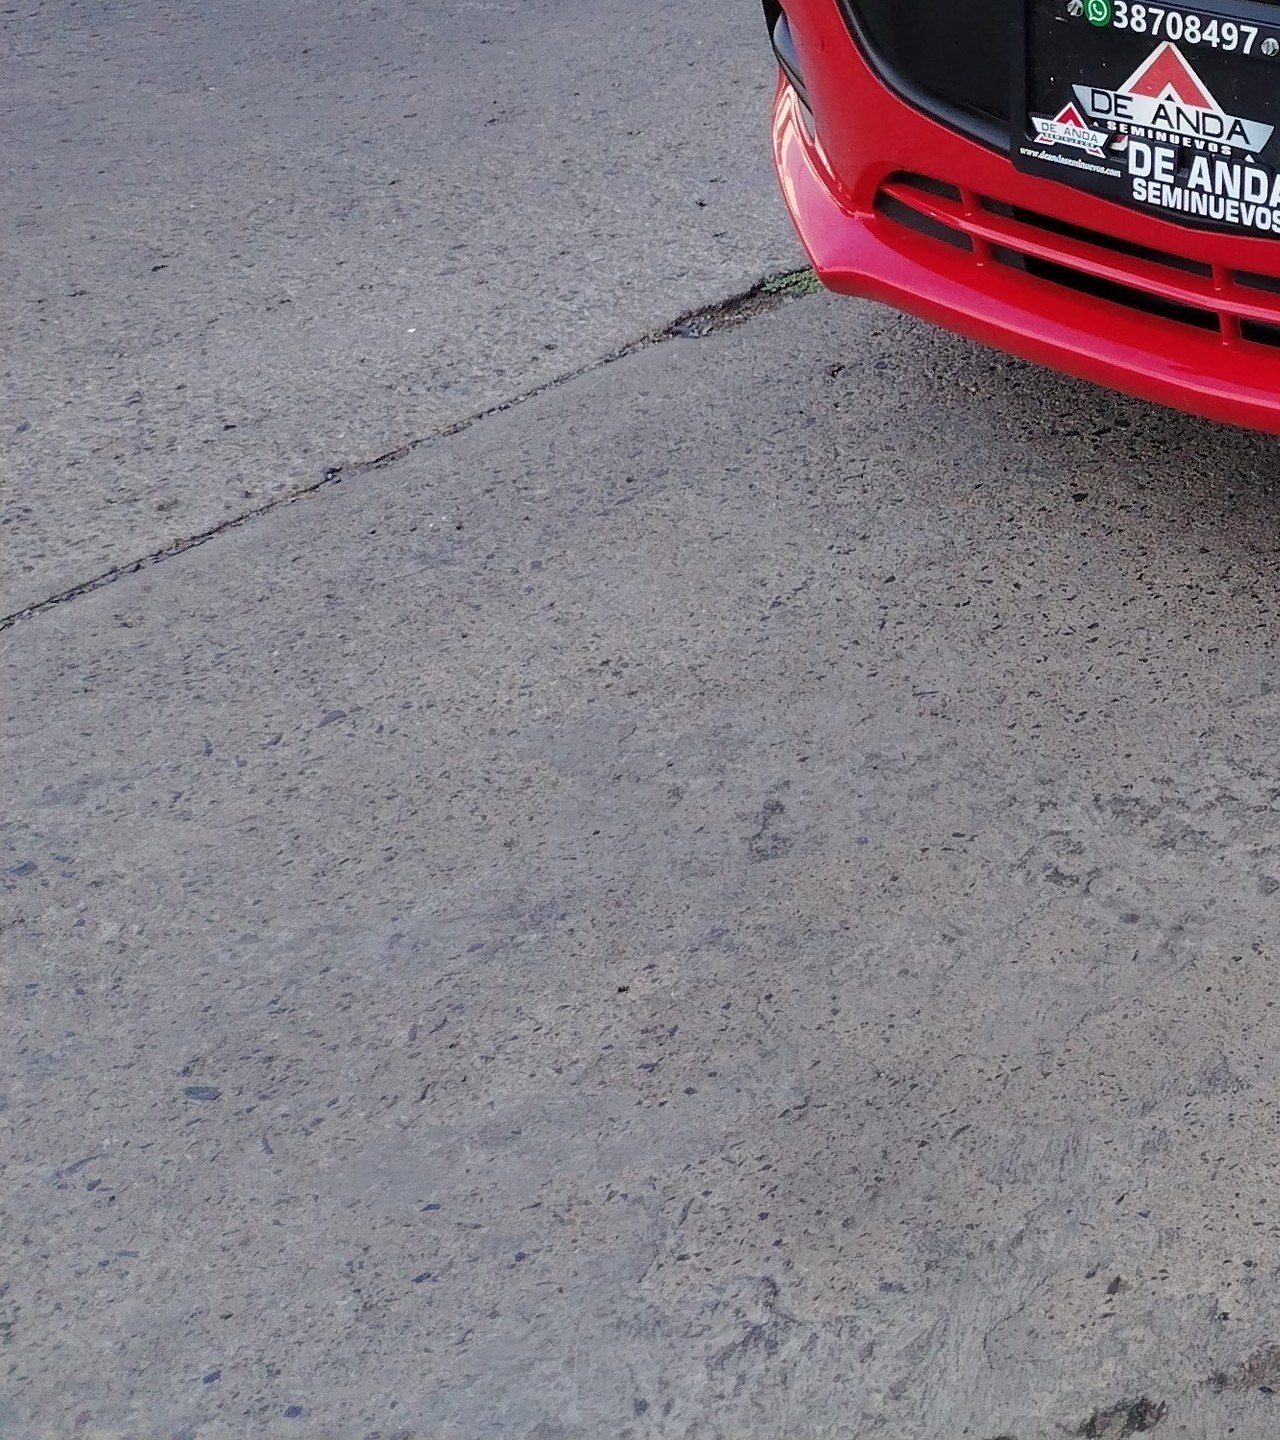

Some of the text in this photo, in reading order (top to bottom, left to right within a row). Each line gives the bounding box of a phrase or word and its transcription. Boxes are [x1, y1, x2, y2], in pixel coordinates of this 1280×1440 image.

[1113, 0, 1258, 54] 38708497
[1041, 122, 1099, 144] DE ANDA
[1091, 88, 1251, 146] DE ANDA
[1106, 120, 1232, 156] SEMINUEVOS
[1128, 141, 1175, 185] DE
